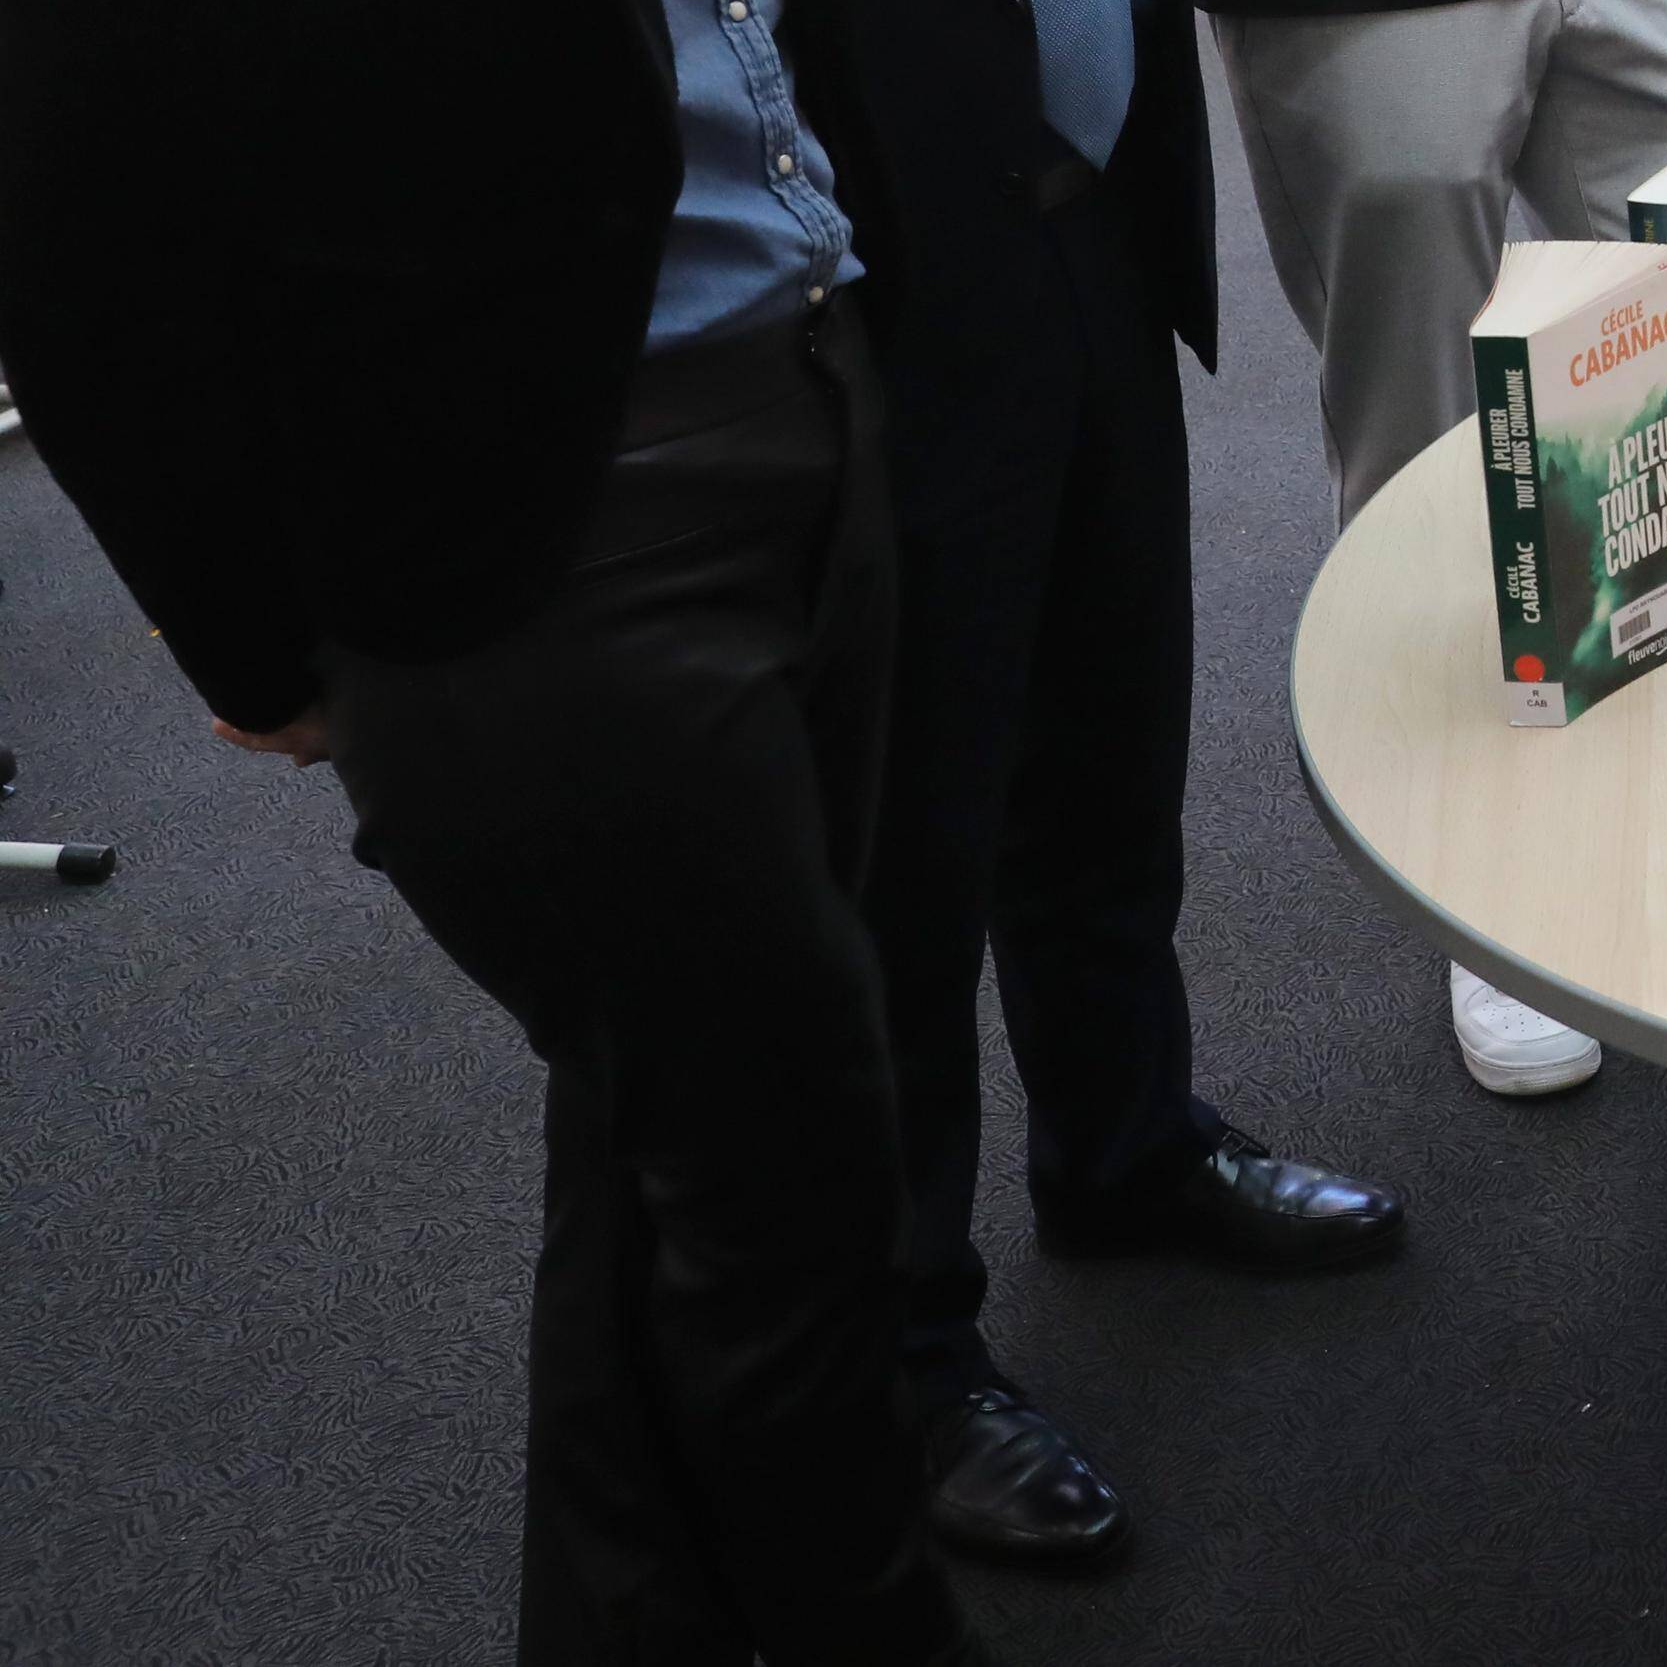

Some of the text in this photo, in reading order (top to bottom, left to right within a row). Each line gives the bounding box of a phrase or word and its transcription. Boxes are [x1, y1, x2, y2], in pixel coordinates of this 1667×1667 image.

[1600, 300, 1644, 336] CÉCILE
[1489, 408, 1512, 459] PLEURER
[1505, 368, 1536, 510] TOUT NOUS CONDAMNE
[1597, 472, 1651, 537] TOUT
[1506, 565, 1520, 599] CÉCILE
[1516, 541, 1541, 624] CABANAC
[1527, 698, 1548, 708] CAB
[1532, 690, 1539, 698] R
